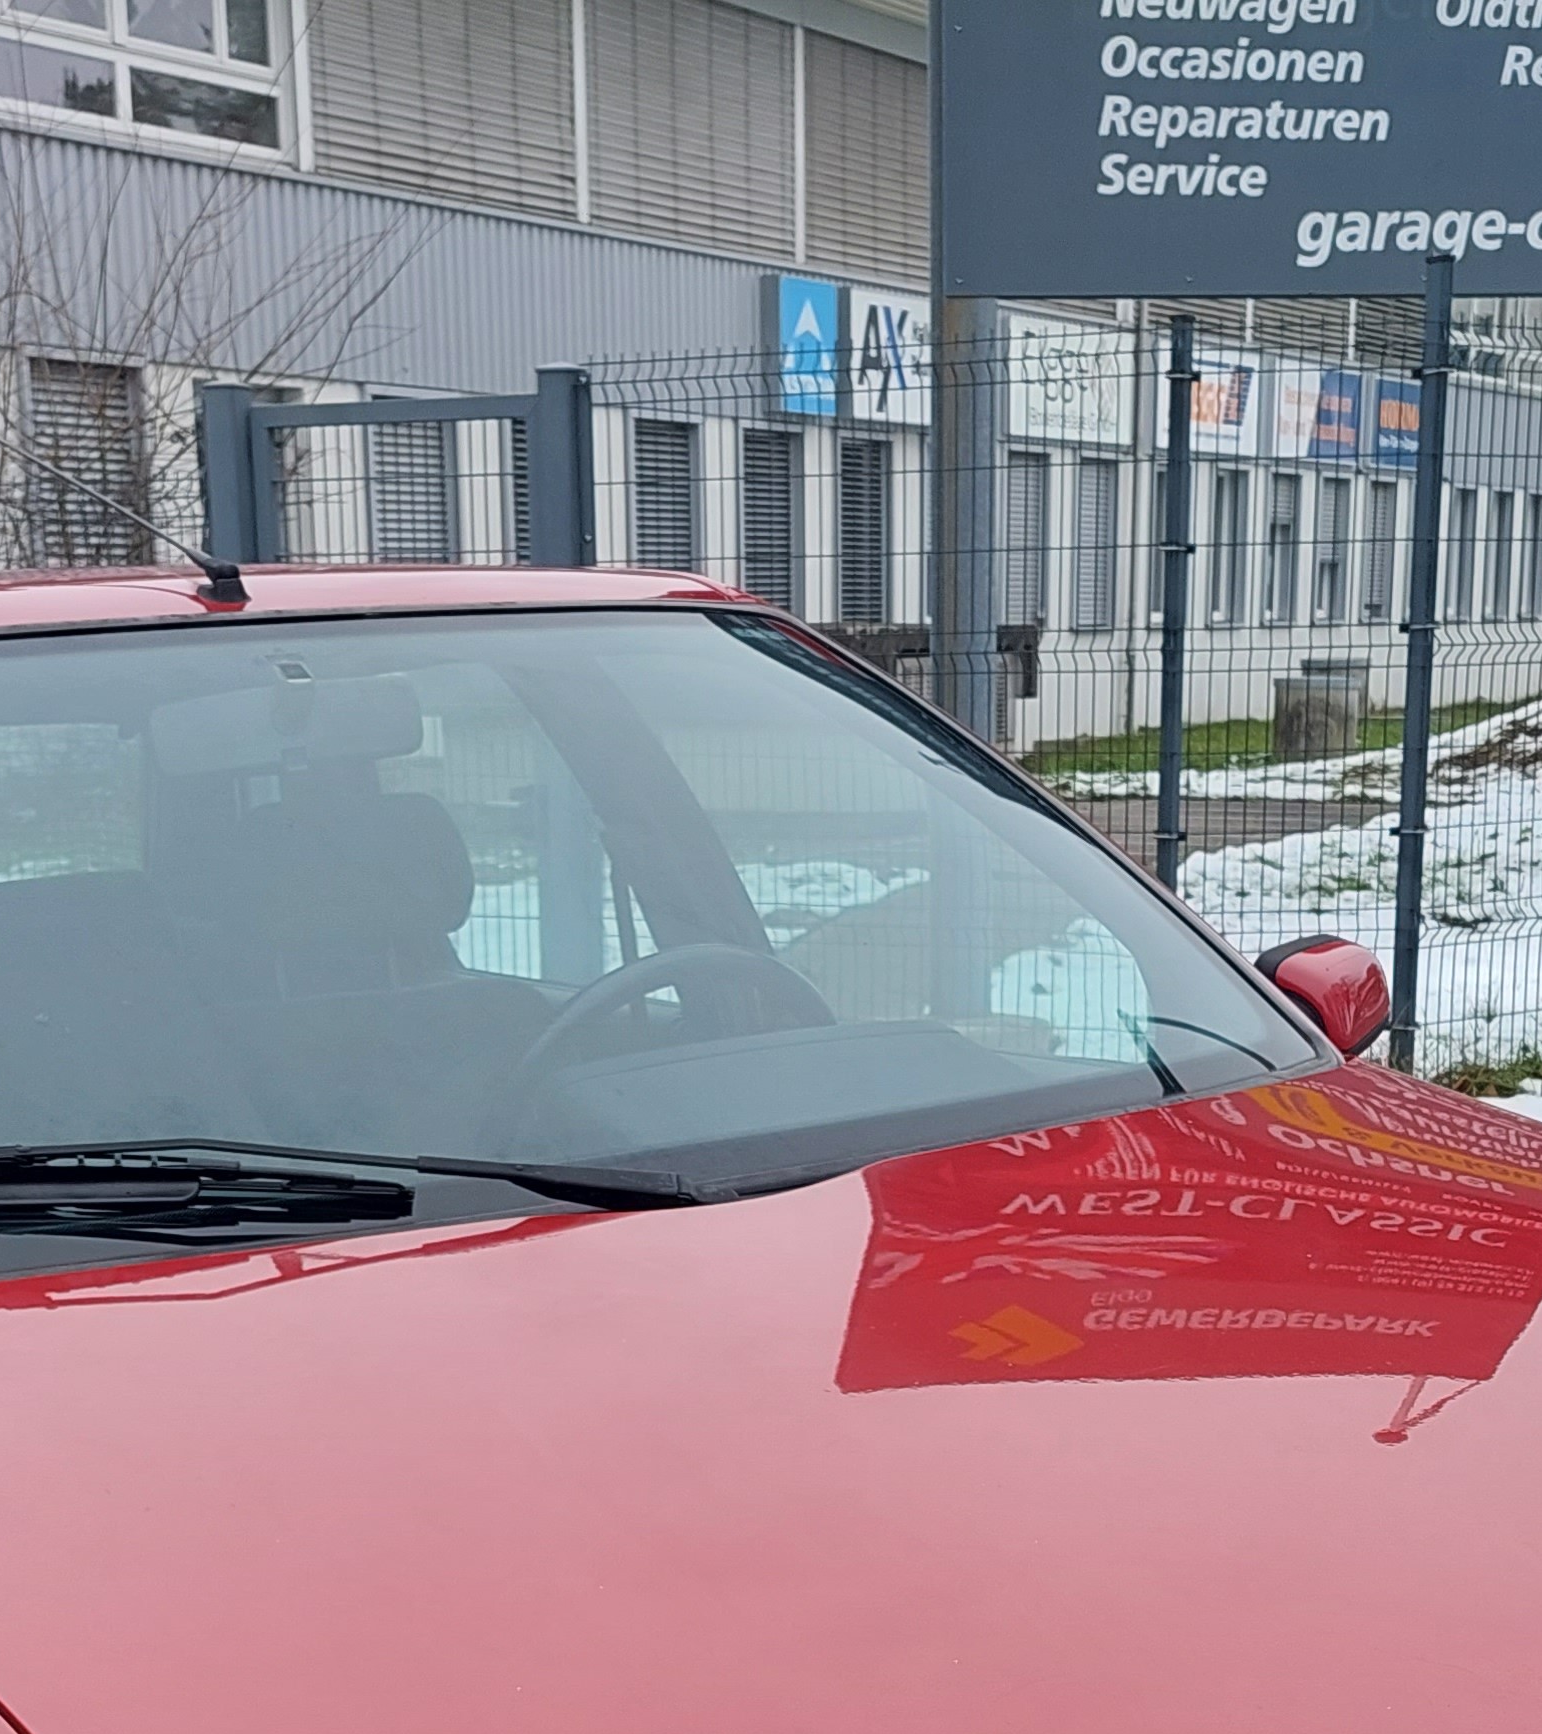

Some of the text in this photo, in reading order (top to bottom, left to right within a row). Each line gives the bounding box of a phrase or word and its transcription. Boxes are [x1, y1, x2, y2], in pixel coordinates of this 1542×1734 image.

[1100, 34, 1365, 83] Occasionen
[1097, 94, 1390, 148] Reparaturen
[1096, 152, 1268, 199] Service
